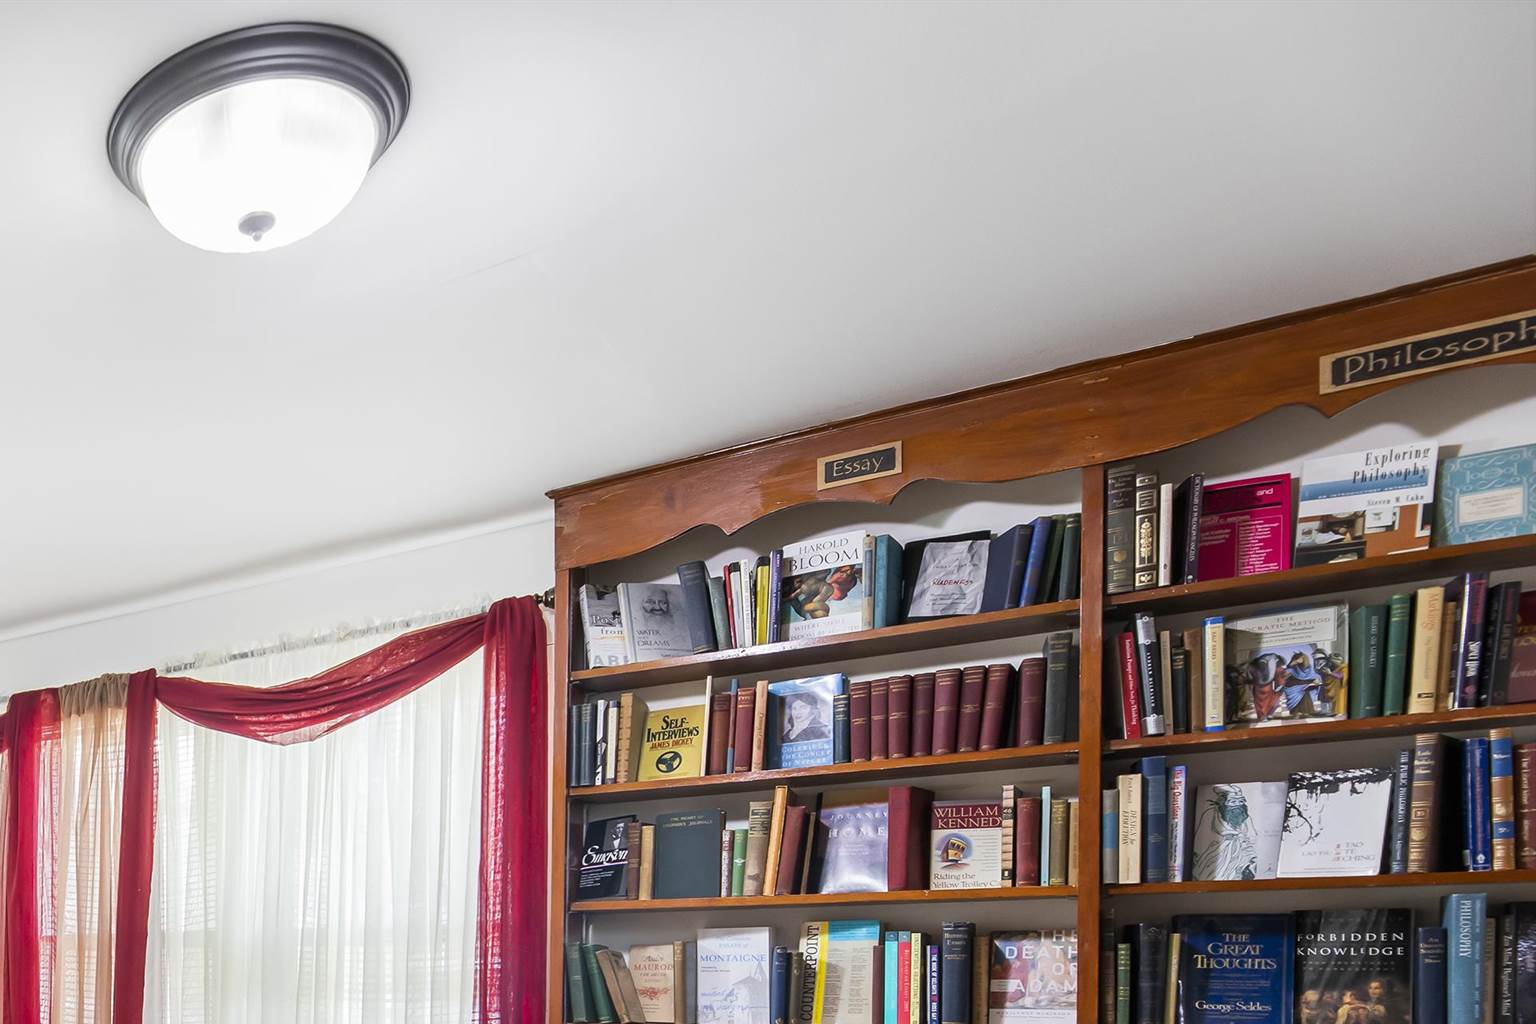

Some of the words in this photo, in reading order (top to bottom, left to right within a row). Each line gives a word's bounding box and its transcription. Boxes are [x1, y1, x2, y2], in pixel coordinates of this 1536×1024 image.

[1365, 445, 1430, 467] Exploring
[832, 455, 884, 477] Essay
[1352, 463, 1427, 485] Philosophy
[1256, 487, 1274, 497] and
[799, 537, 849, 555] HAROLD
[788, 548, 860, 573] BLOOM
[1276, 616, 1293, 624] THE
[1422, 593, 1440, 632] Markings
[1288, 617, 1331, 628] METHOD
[636, 629, 662, 637] WATER
[636, 639, 672, 648] DREAMS
[1124, 638, 1132, 659] Intuition
[1125, 658, 1133, 674] Pumps
[1129, 704, 1138, 725] Thinking
[660, 714, 690, 732] SELF-
[646, 725, 700, 744] INTERVIEWS
[648, 740, 670, 751] JAMES
[671, 736, 695, 748] DICKEY
[1174, 769, 1183, 780] The
[1399, 764, 1409, 786] PUBLIC
[1170, 780, 1183, 790] Big
[933, 805, 998, 819] WILLIAM
[1171, 791, 1182, 821] Questions
[1397, 788, 1408, 823] PHILOSOPHY
[937, 815, 1003, 829] KENNEDY
[827, 824, 888, 840] HOME
[1344, 841, 1365, 849] TAO
[1344, 848, 1357, 856] TE
[582, 844, 629, 867] Emerson
[1341, 854, 1376, 863] CHING
[933, 872, 961, 882] Riding
[961, 871, 976, 880] the
[930, 880, 961, 890] Yellow
[962, 879, 990, 890] Trolley
[1040, 929, 1077, 943] THE
[1458, 899, 1473, 958] PHILOSOPHY
[1222, 932, 1250, 944] THE
[1296, 932, 1405, 943] FORBIDDEN
[1503, 935, 1513, 946] Zen
[930, 953, 938, 962] THE
[1004, 945, 1077, 960] DEATH
[1207, 942, 1264, 958] GREAT
[1296, 946, 1405, 957] KNOWLEDGE
[1503, 947, 1512, 966] Mind,
[699, 953, 767, 963] MONTAIGNE
[1193, 954, 1278, 970] THOUGHTS
[800, 924, 821, 1022] COUNTERPOINT
[930, 962, 938, 971] BOOK
[930, 977, 938, 995] DELIGHTS
[1013, 979, 1077, 993] ADAM
[1194, 1000, 1237, 1014] George
[1236, 1000, 1272, 1013] Seldes
[1501, 998, 1511, 1016] Mind
